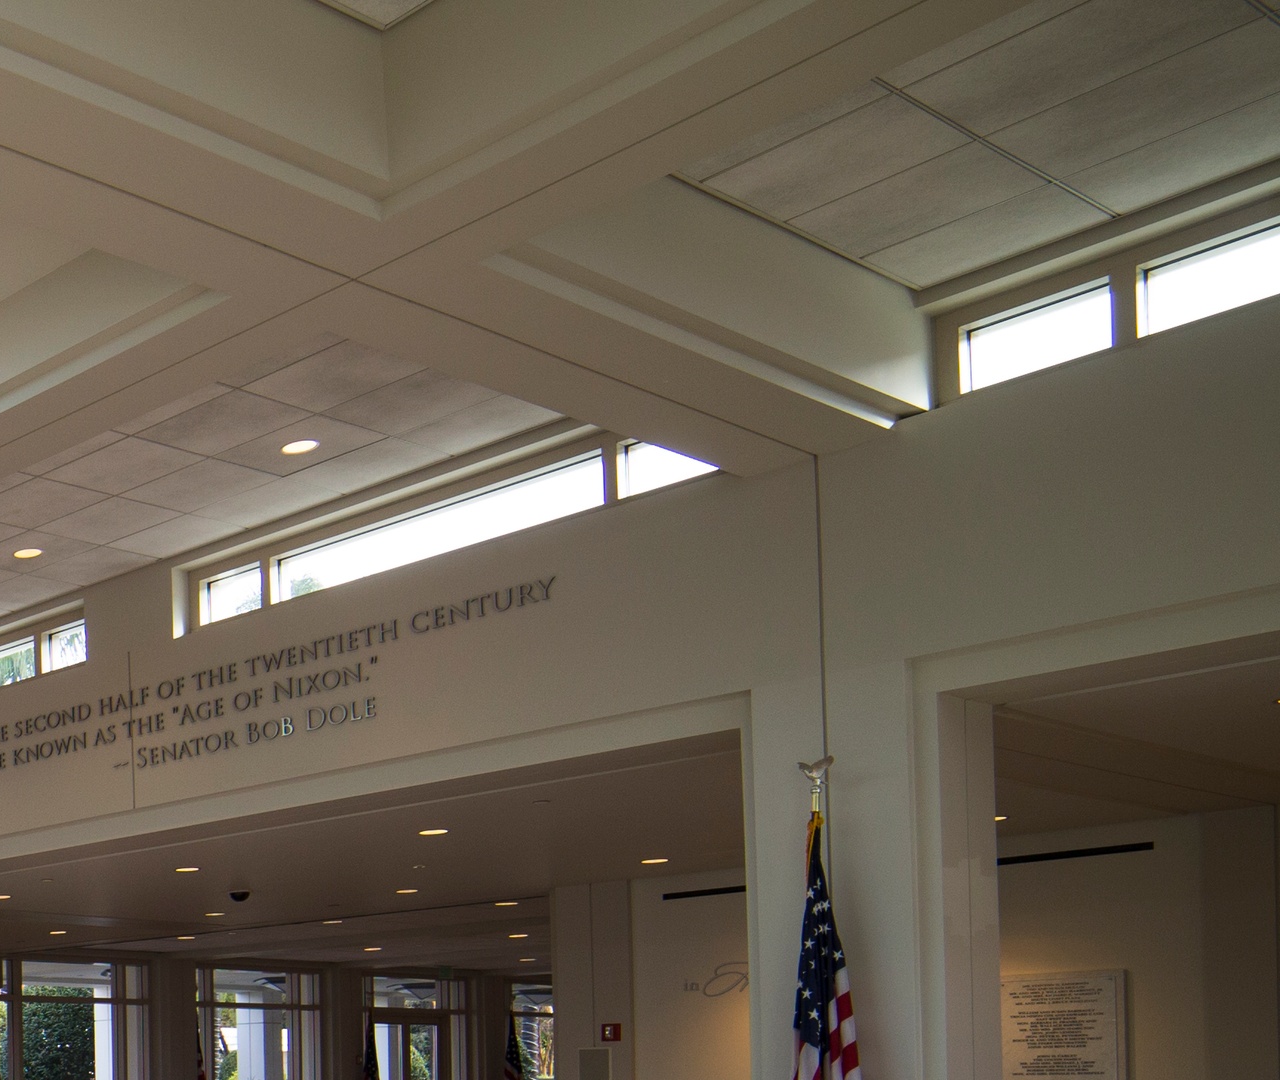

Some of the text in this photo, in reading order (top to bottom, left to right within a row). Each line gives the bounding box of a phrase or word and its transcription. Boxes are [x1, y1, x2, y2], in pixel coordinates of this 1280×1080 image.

[13, 732, 88, 766] KNOWN
[92, 724, 118, 748] AS
[121, 711, 166, 740] THE
[171, 697, 225, 728] "AGE
[232, 686, 264, 713] OF
[272, 656, 380, 703] NIXON."
[14, 702, 92, 740] SECOND
[98, 685, 150, 717] HALF
[157, 676, 186, 700] OF
[191, 661, 238, 692] THE
[244, 619, 399, 678] TWENTIETH
[410, 576, 557, 635] CENTURY
[136, 732, 238, 770] SENATOR
[246, 716, 295, 746] BOB
[305, 697, 377, 732] DOLE
